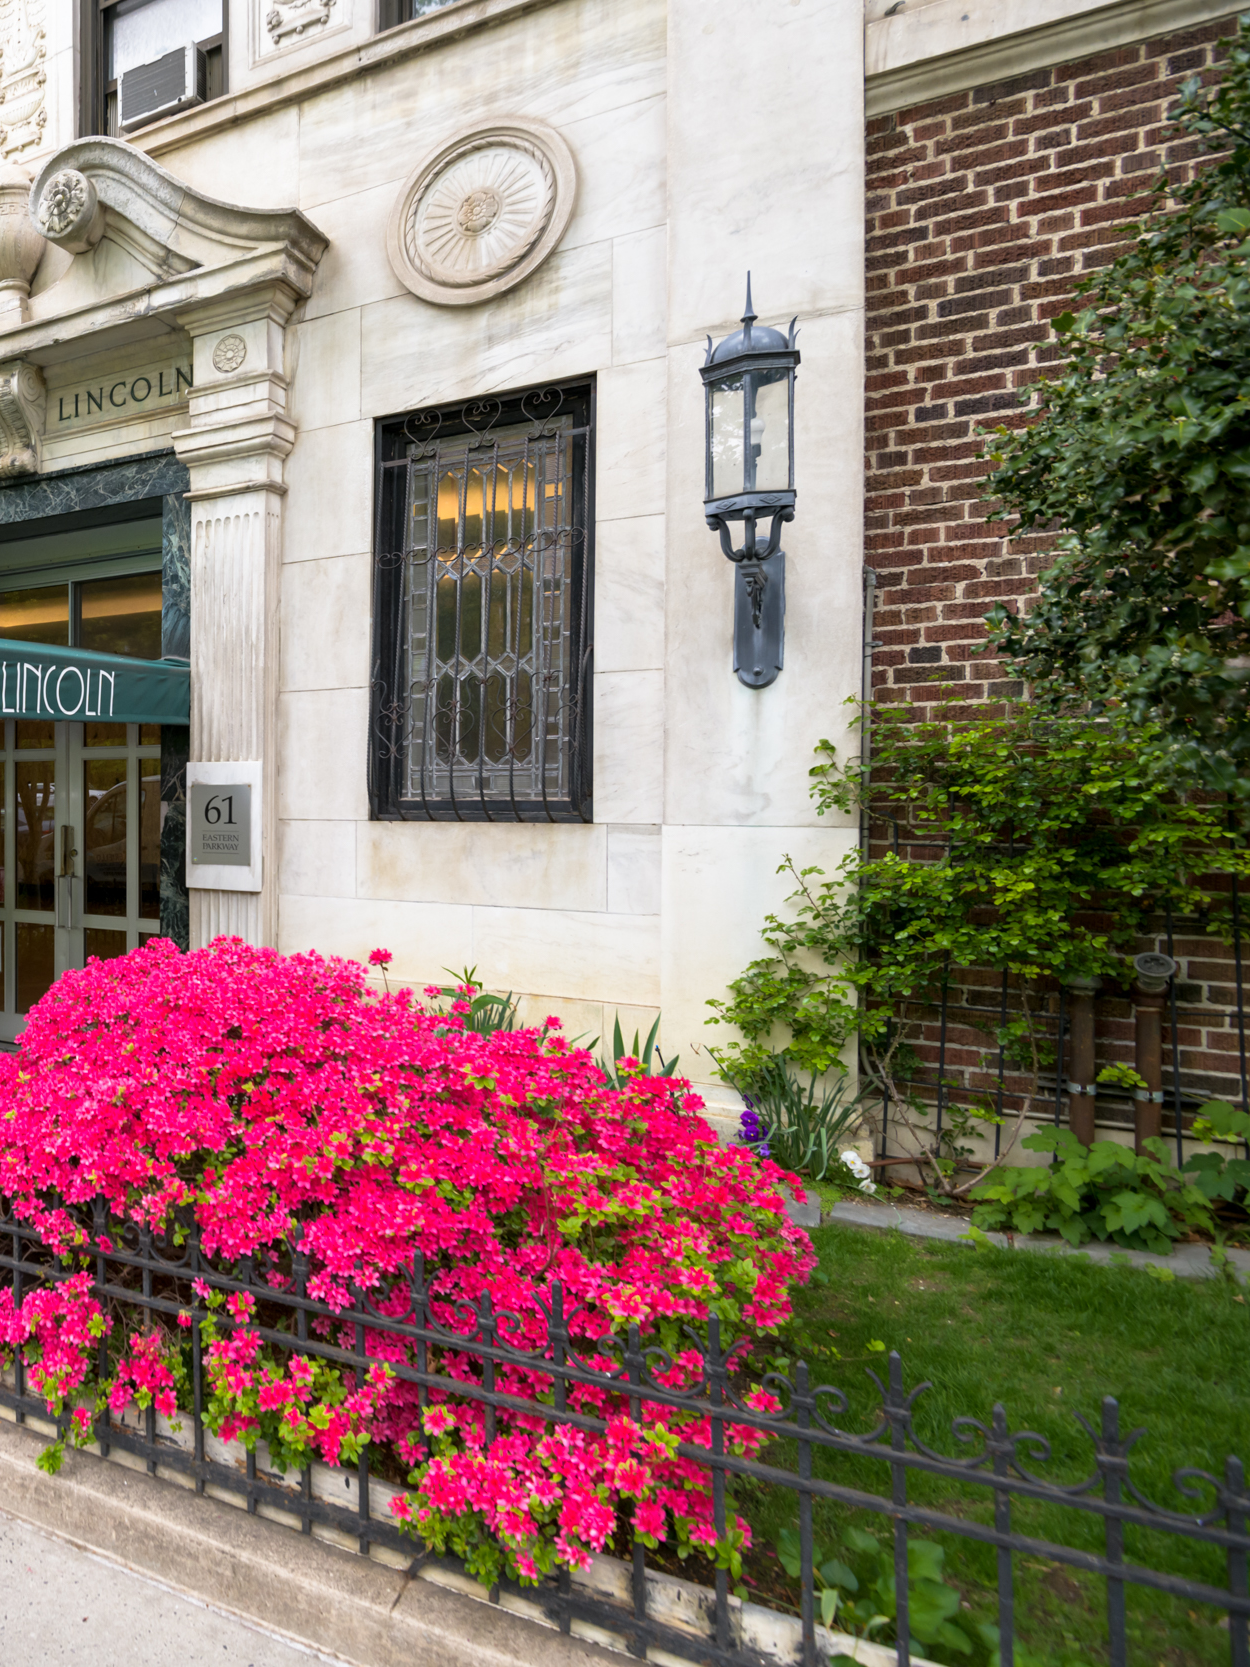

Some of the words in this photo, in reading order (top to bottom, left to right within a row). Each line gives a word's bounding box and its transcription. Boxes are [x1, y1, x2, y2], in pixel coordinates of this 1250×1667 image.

[58, 363, 194, 422] LINCOLN
[1, 661, 115, 717] LINCOLN
[204, 795, 237, 825] 61
[202, 833, 240, 842] EASTERN
[202, 842, 240, 851] PARKWAY
